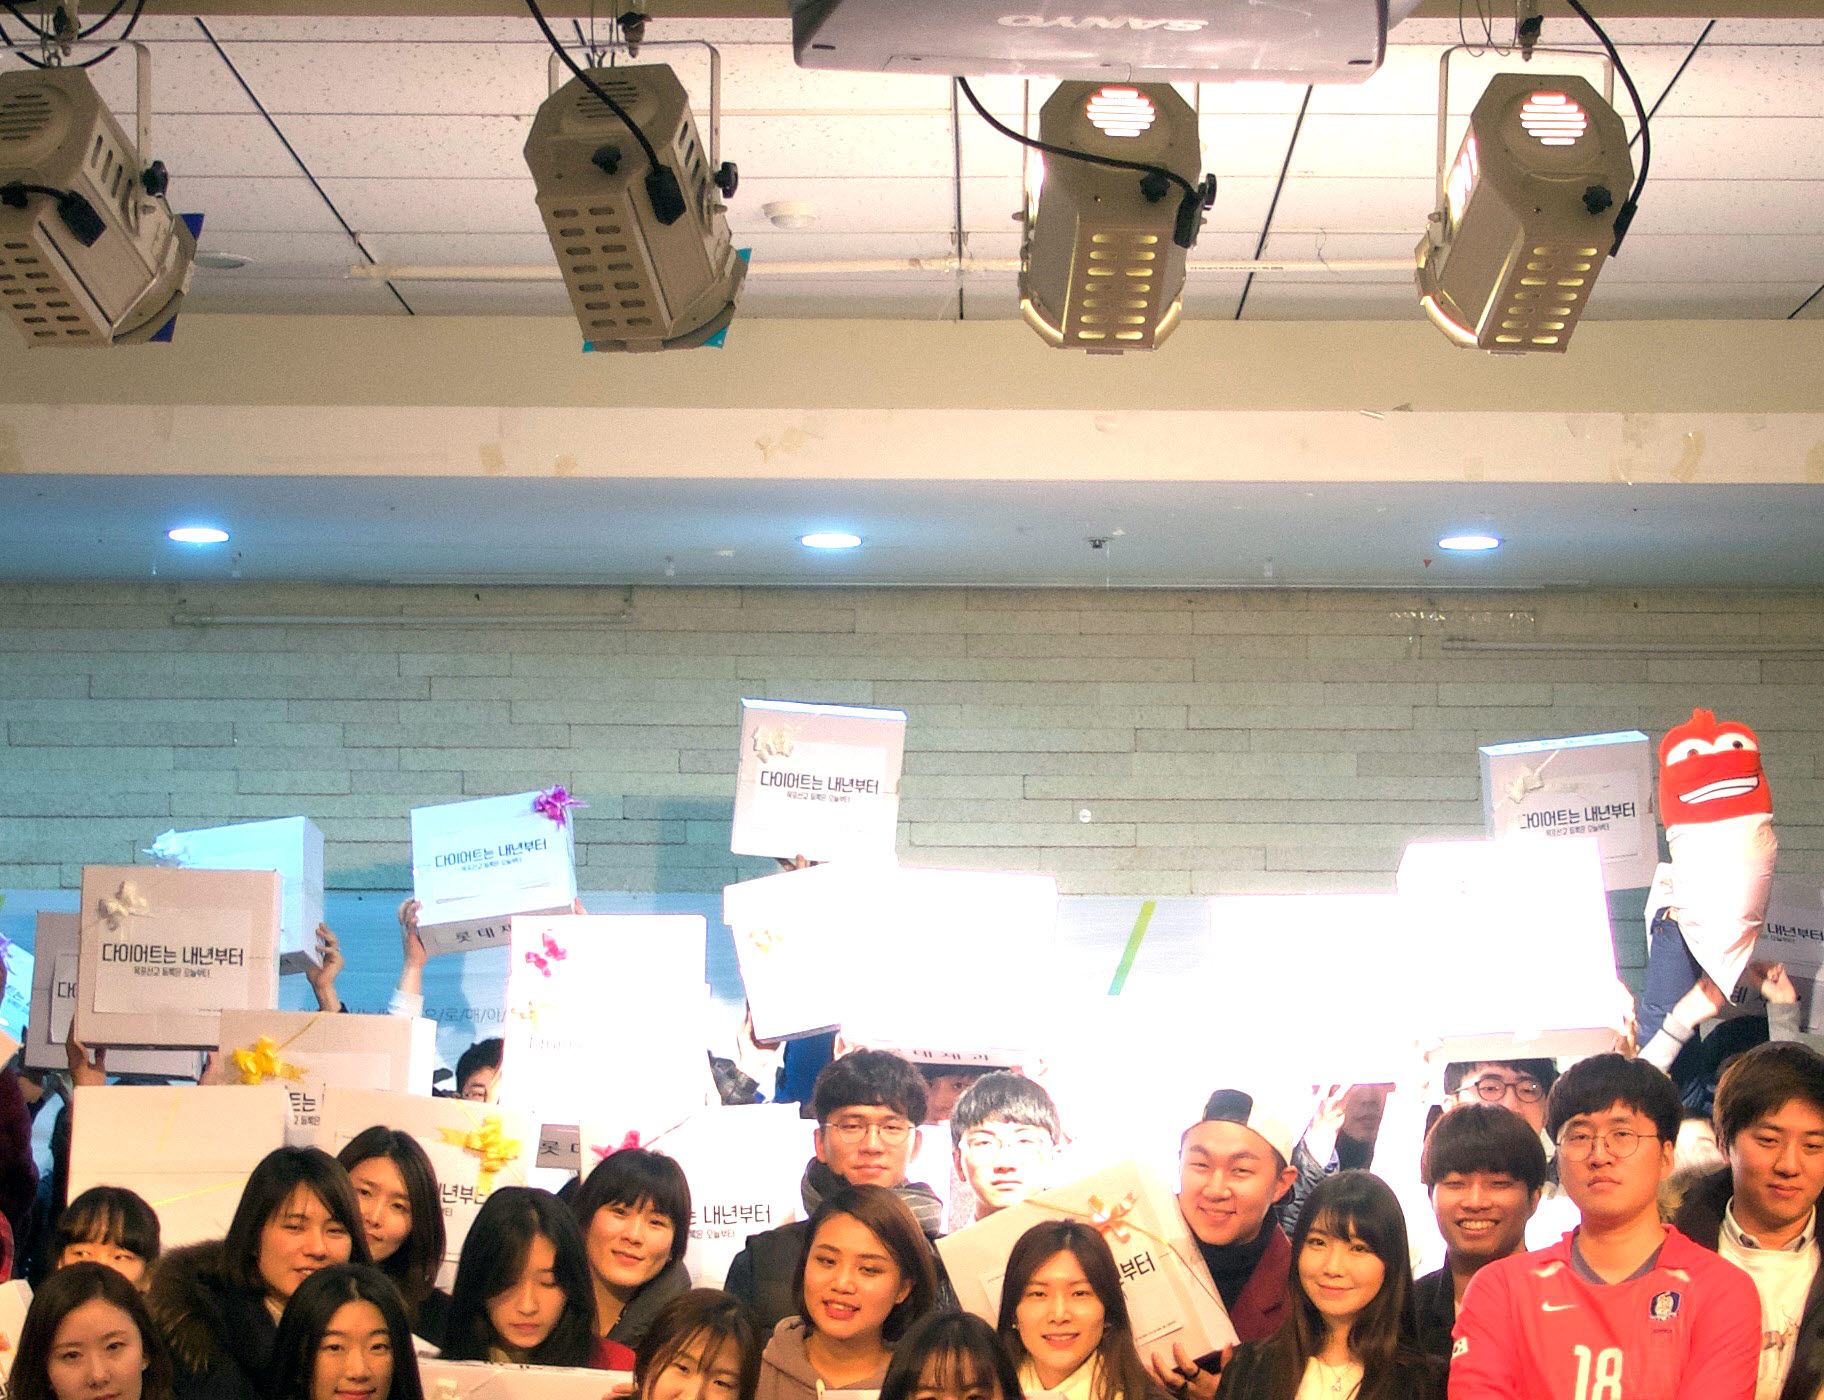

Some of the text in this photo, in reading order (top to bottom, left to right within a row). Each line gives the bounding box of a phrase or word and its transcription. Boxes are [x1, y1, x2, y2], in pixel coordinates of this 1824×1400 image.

[997, 15, 1209, 31] SANYO
[761, 770, 878, 794] 다이어트는 내년부터
[1584, 802, 1636, 822] 내년부터
[435, 838, 547, 868] 다이어트는 내년부터
[1767, 922, 1824, 941] 내년부터
[102, 943, 244, 966] 다이어트는 내년부터
[704, 1204, 770, 1225] 내년부터
[707, 1230, 735, 1239] 오늘부터
